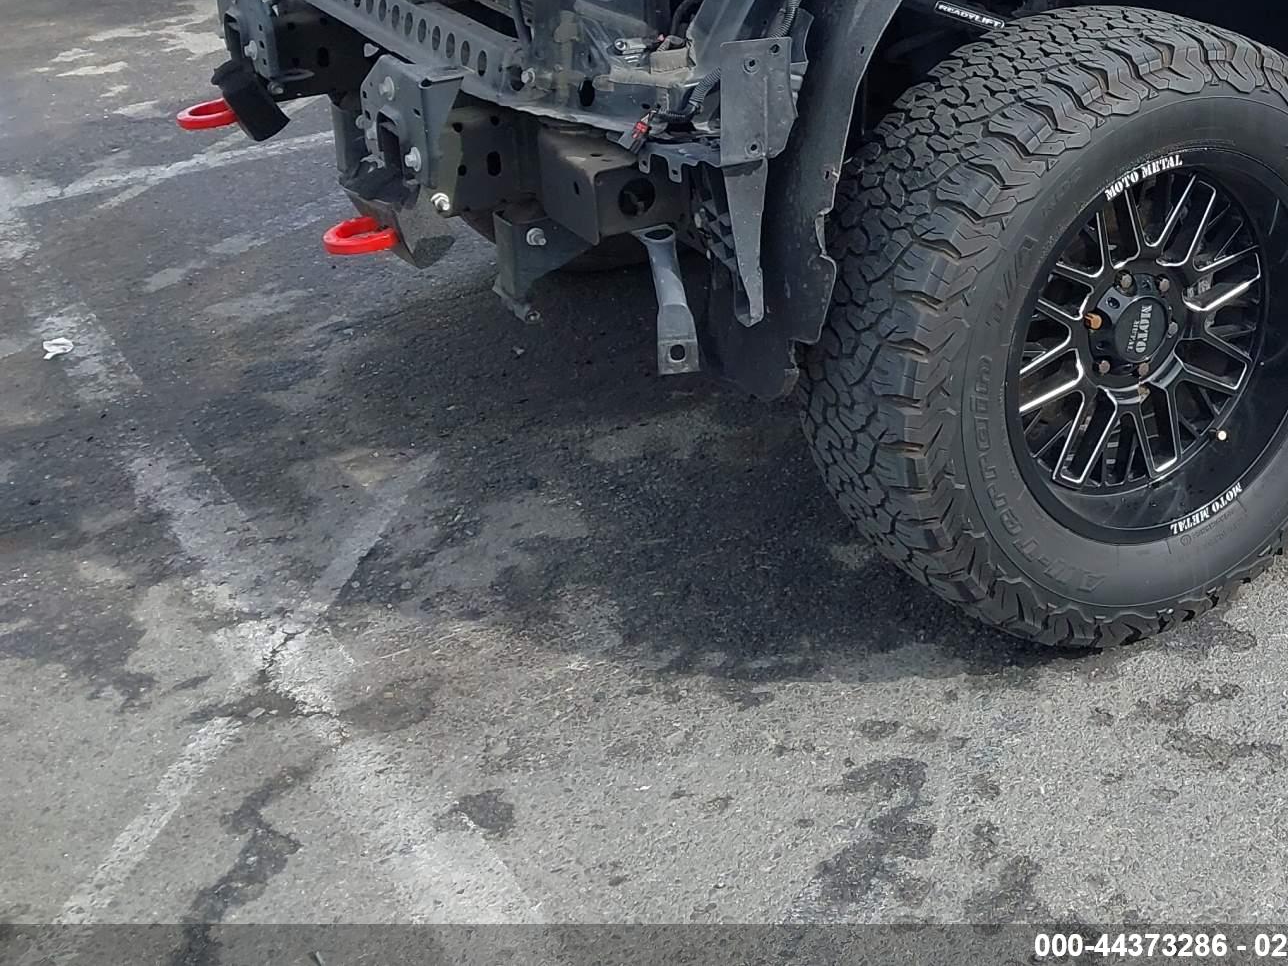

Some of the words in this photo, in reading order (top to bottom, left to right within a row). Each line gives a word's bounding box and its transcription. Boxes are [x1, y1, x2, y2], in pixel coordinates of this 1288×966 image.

[937, 3, 1002, 28] READYLIFT
[1104, 171, 1139, 202] MOTO
[1141, 154, 1183, 178] METAL
[1126, 319, 1140, 352] METAL
[1135, 304, 1153, 353] MOTO
[1211, 481, 1243, 513] MOTO
[1169, 506, 1211, 535] METAL
